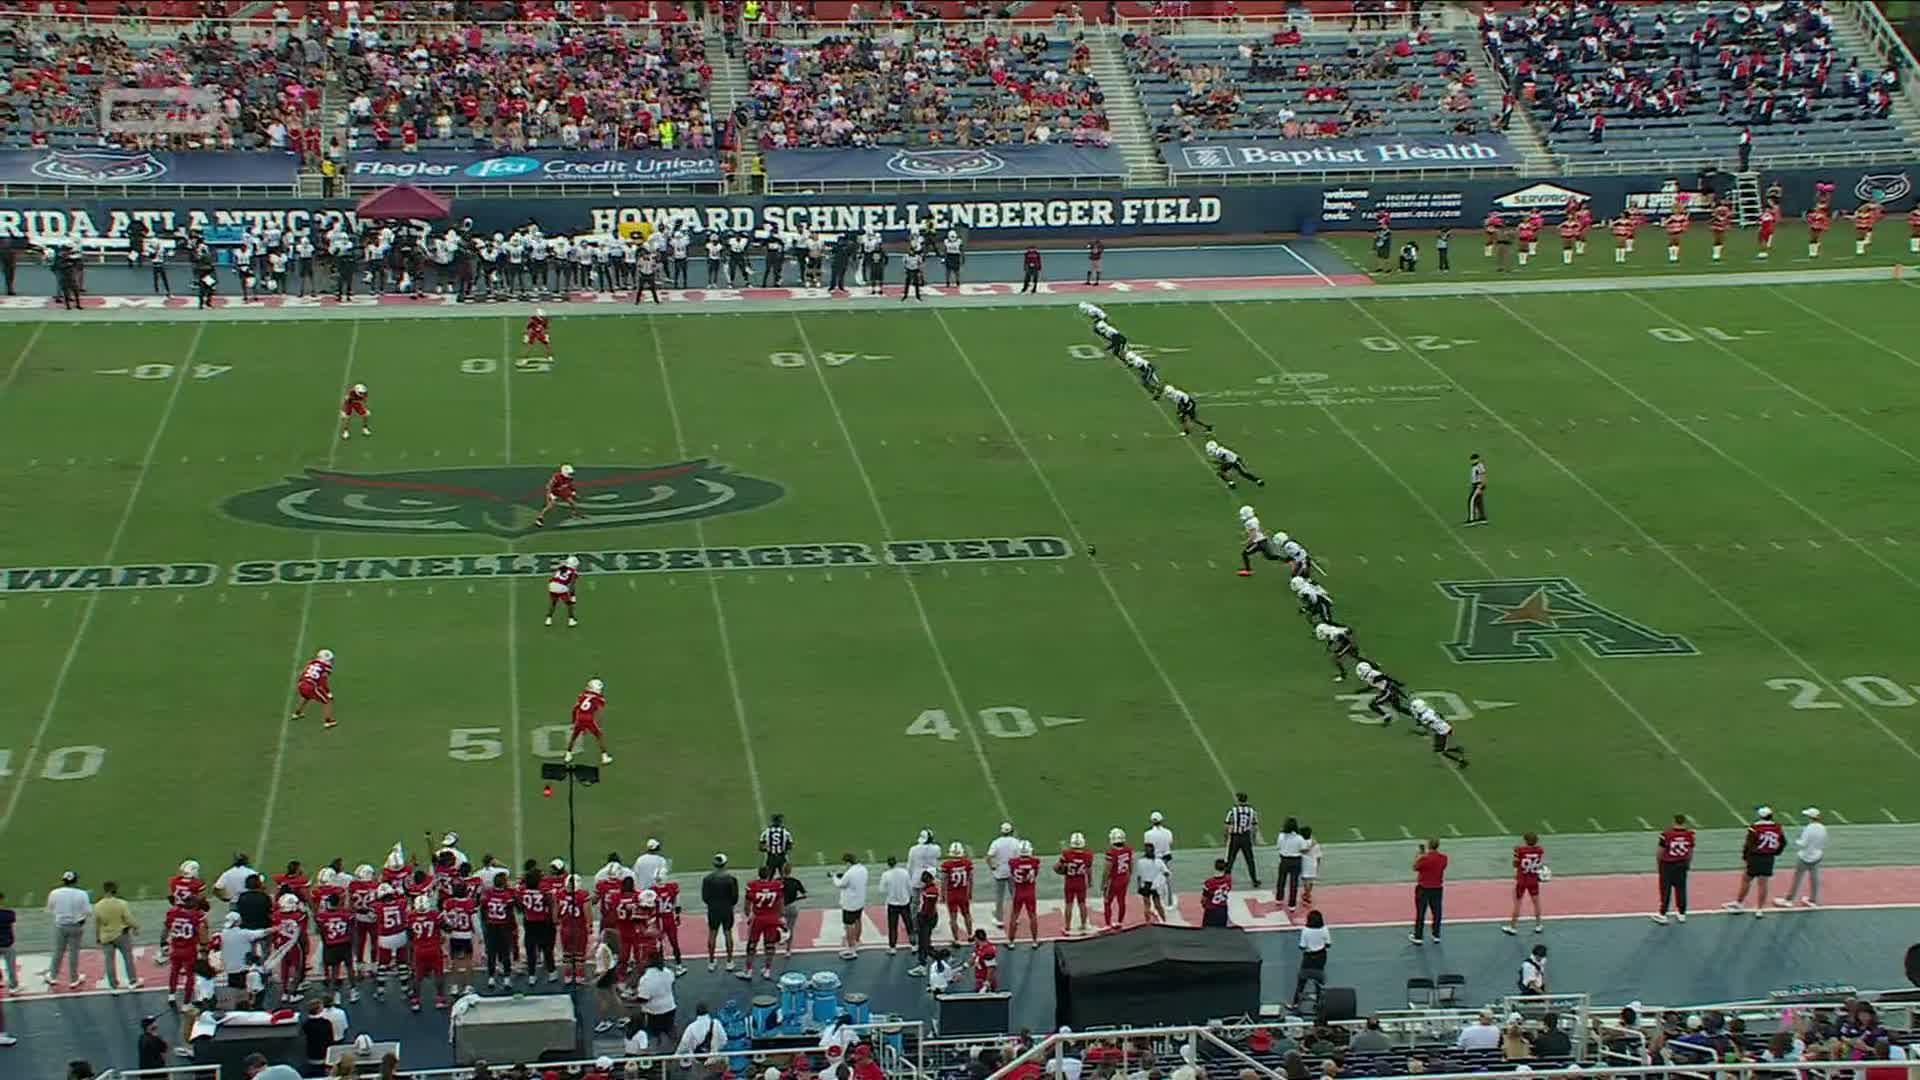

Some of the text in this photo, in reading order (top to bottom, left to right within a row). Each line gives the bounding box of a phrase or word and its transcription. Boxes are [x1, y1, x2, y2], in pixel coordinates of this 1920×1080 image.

[1242, 142, 1498, 166] Baptist Health
[353, 161, 459, 176] Flagler
[543, 160, 628, 174] Credit
[635, 157, 713, 173] Union
[591, 197, 1222, 234] HOWARD SCHNELLENBERGER FIELD
[232, 544, 876, 585] SCHNELLENBERGER
[886, 537, 1069, 563] FIELD
[1764, 676, 1919, 710] 20
[580, 696, 592, 711] 6
[904, 706, 1039, 741] 40
[448, 726, 584, 761] 50
[771, 832, 782, 846] S
[951, 870, 967, 887] 91
[1013, 869, 1037, 883] 54
[523, 894, 544, 912] 93
[755, 892, 777, 907] 77
[173, 920, 194, 938] 50
[323, 921, 348, 939] 39
[412, 921, 435, 938] 97
